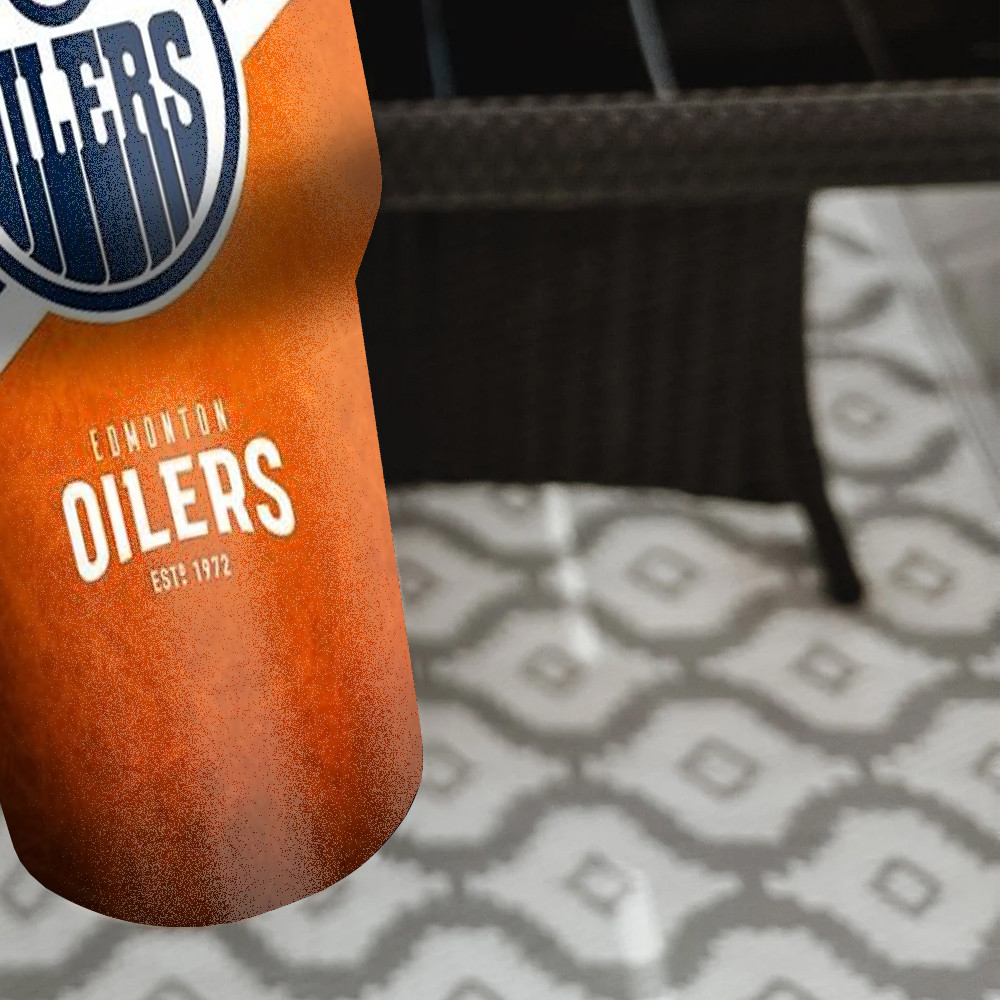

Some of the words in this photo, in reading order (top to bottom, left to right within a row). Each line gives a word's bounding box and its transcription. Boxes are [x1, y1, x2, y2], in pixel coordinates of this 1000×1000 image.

[88, 398, 228, 462] EDMONTON
[62, 436, 296, 583] OILERS
[192, 553, 232, 582] 1972
